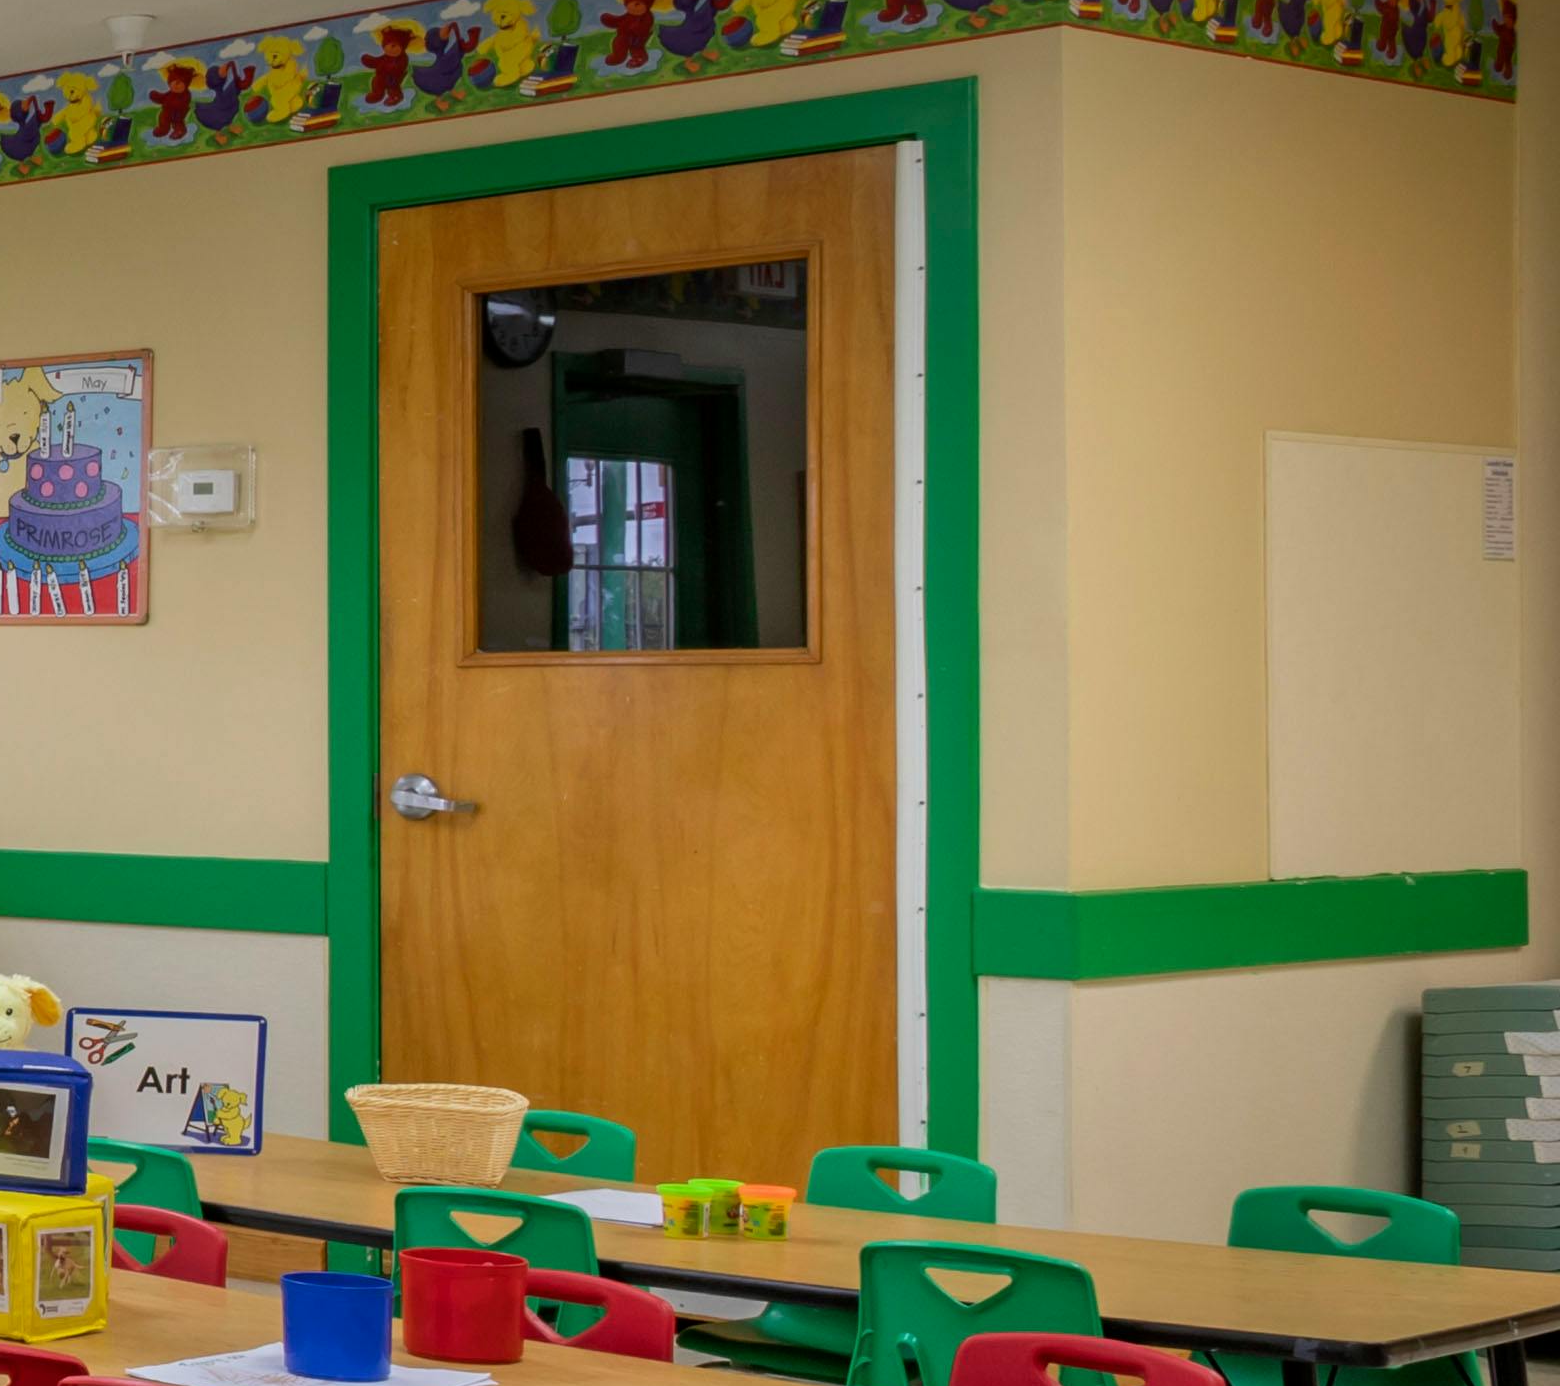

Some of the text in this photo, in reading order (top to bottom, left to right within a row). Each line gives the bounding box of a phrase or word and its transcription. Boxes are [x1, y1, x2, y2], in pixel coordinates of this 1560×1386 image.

[81, 376, 108, 391] May
[17, 517, 113, 551] PRIMROSE
[137, 1065, 190, 1096] Art
